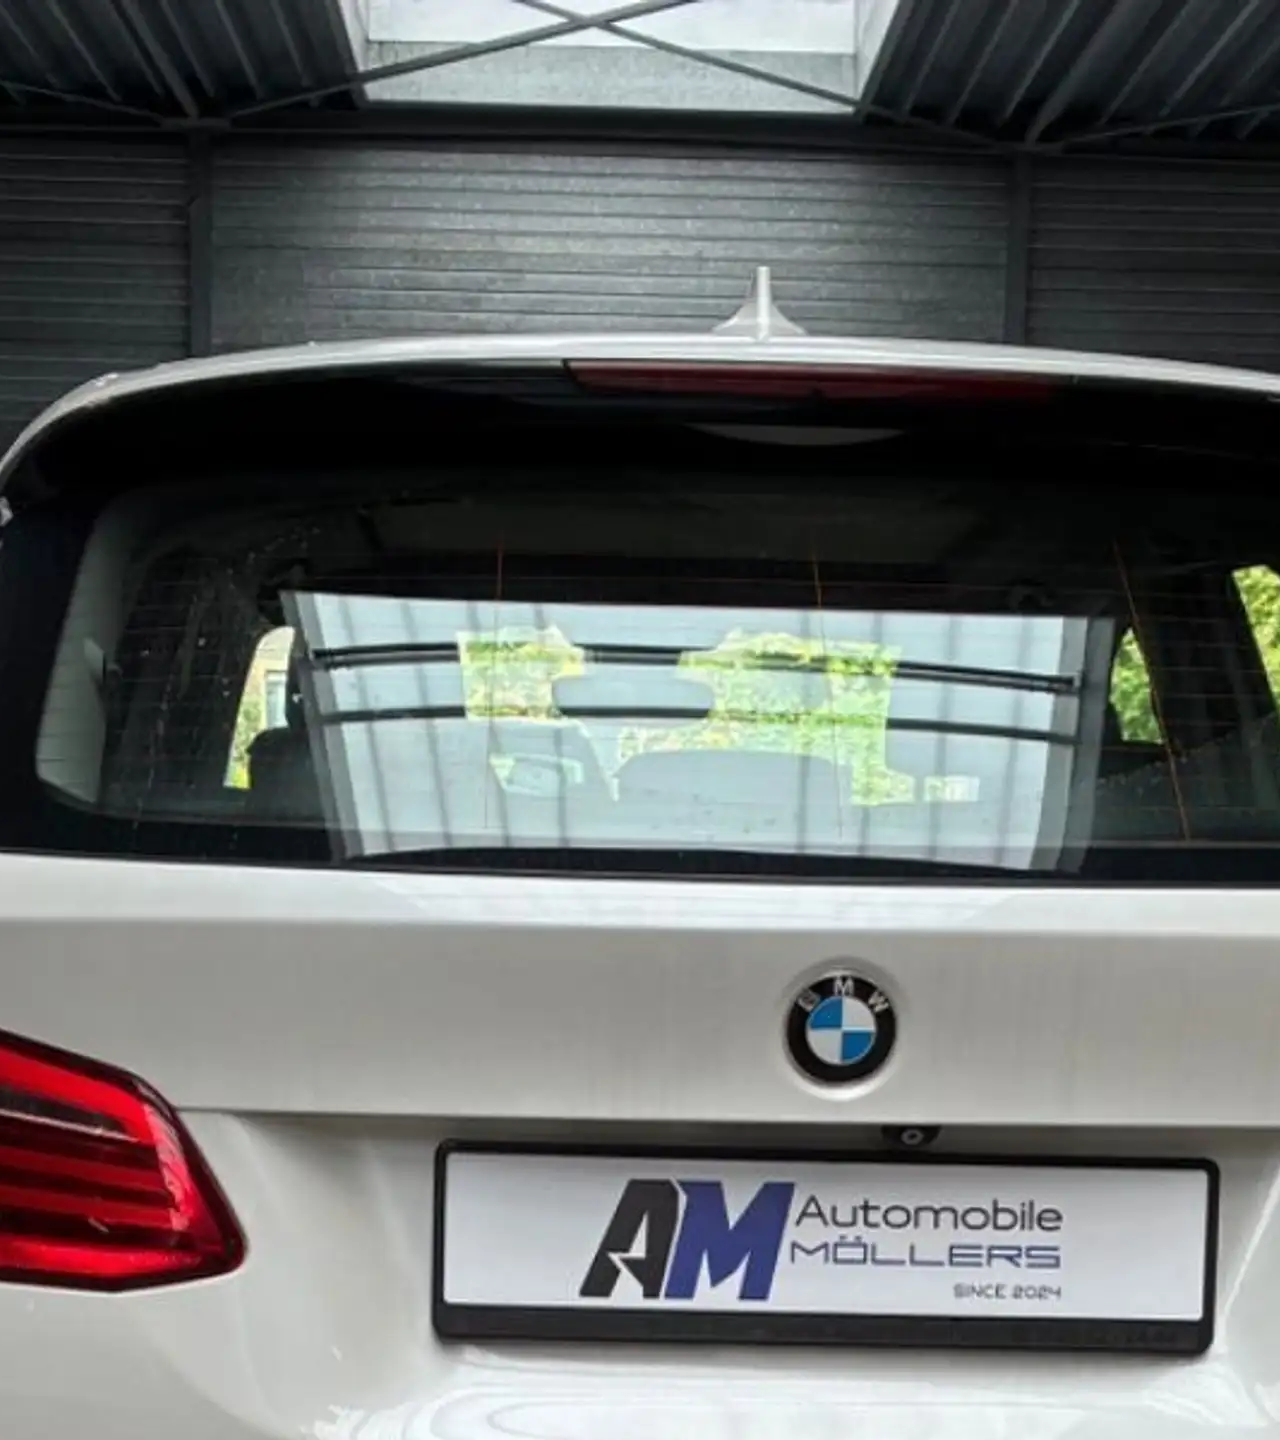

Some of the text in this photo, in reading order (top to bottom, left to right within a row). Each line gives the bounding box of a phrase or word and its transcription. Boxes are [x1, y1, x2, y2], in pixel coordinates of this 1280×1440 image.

[797, 975, 890, 1013] BMW
[795, 1194, 1064, 1232] Automobile
[790, 1234, 1061, 1269] MÖLLERS
